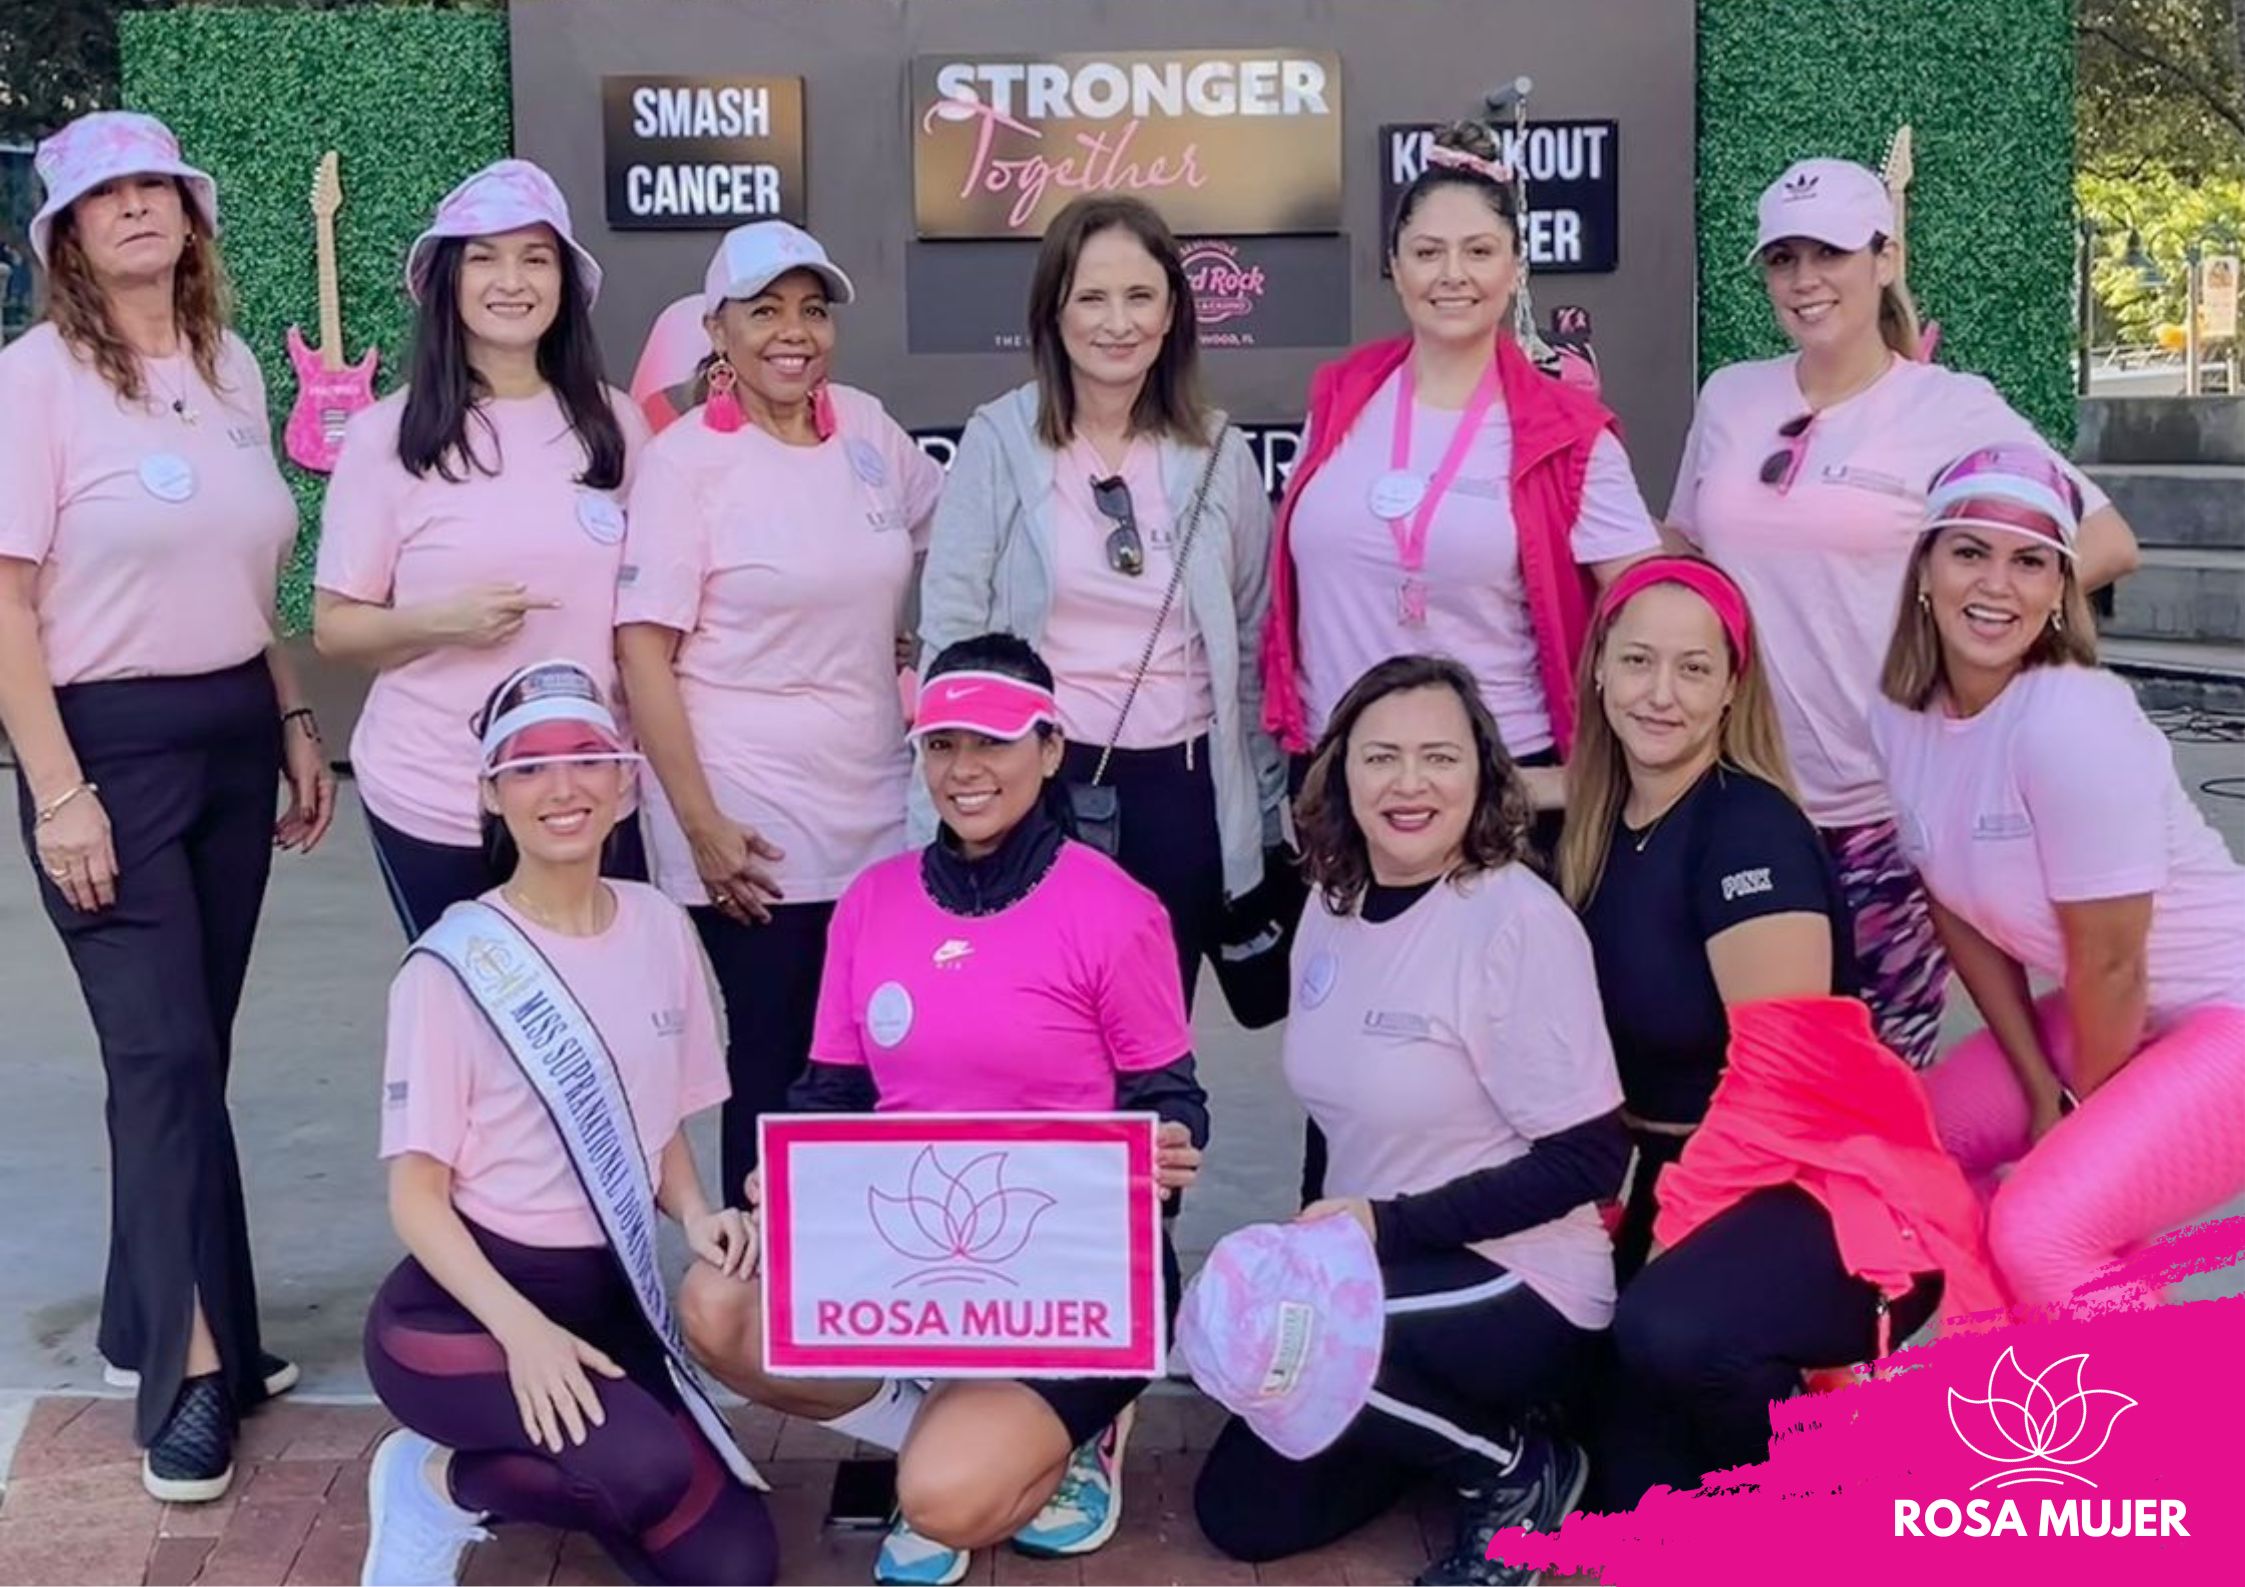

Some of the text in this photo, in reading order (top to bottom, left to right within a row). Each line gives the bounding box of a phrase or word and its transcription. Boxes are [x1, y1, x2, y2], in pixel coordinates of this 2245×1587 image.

[633, 86, 770, 137] SMASH
[936, 60, 1329, 121] STRONGER
[923, 96, 1208, 227] Together
[1392, 126, 1609, 183] KKOUT
[627, 164, 780, 215] CANCER
[1209, 266, 1265, 295] Rock
[510, 989, 568, 1051] MISS
[541, 1036, 630, 1199] SUPRANATIONAL
[817, 1299, 1112, 1339] ROSA MUJER
